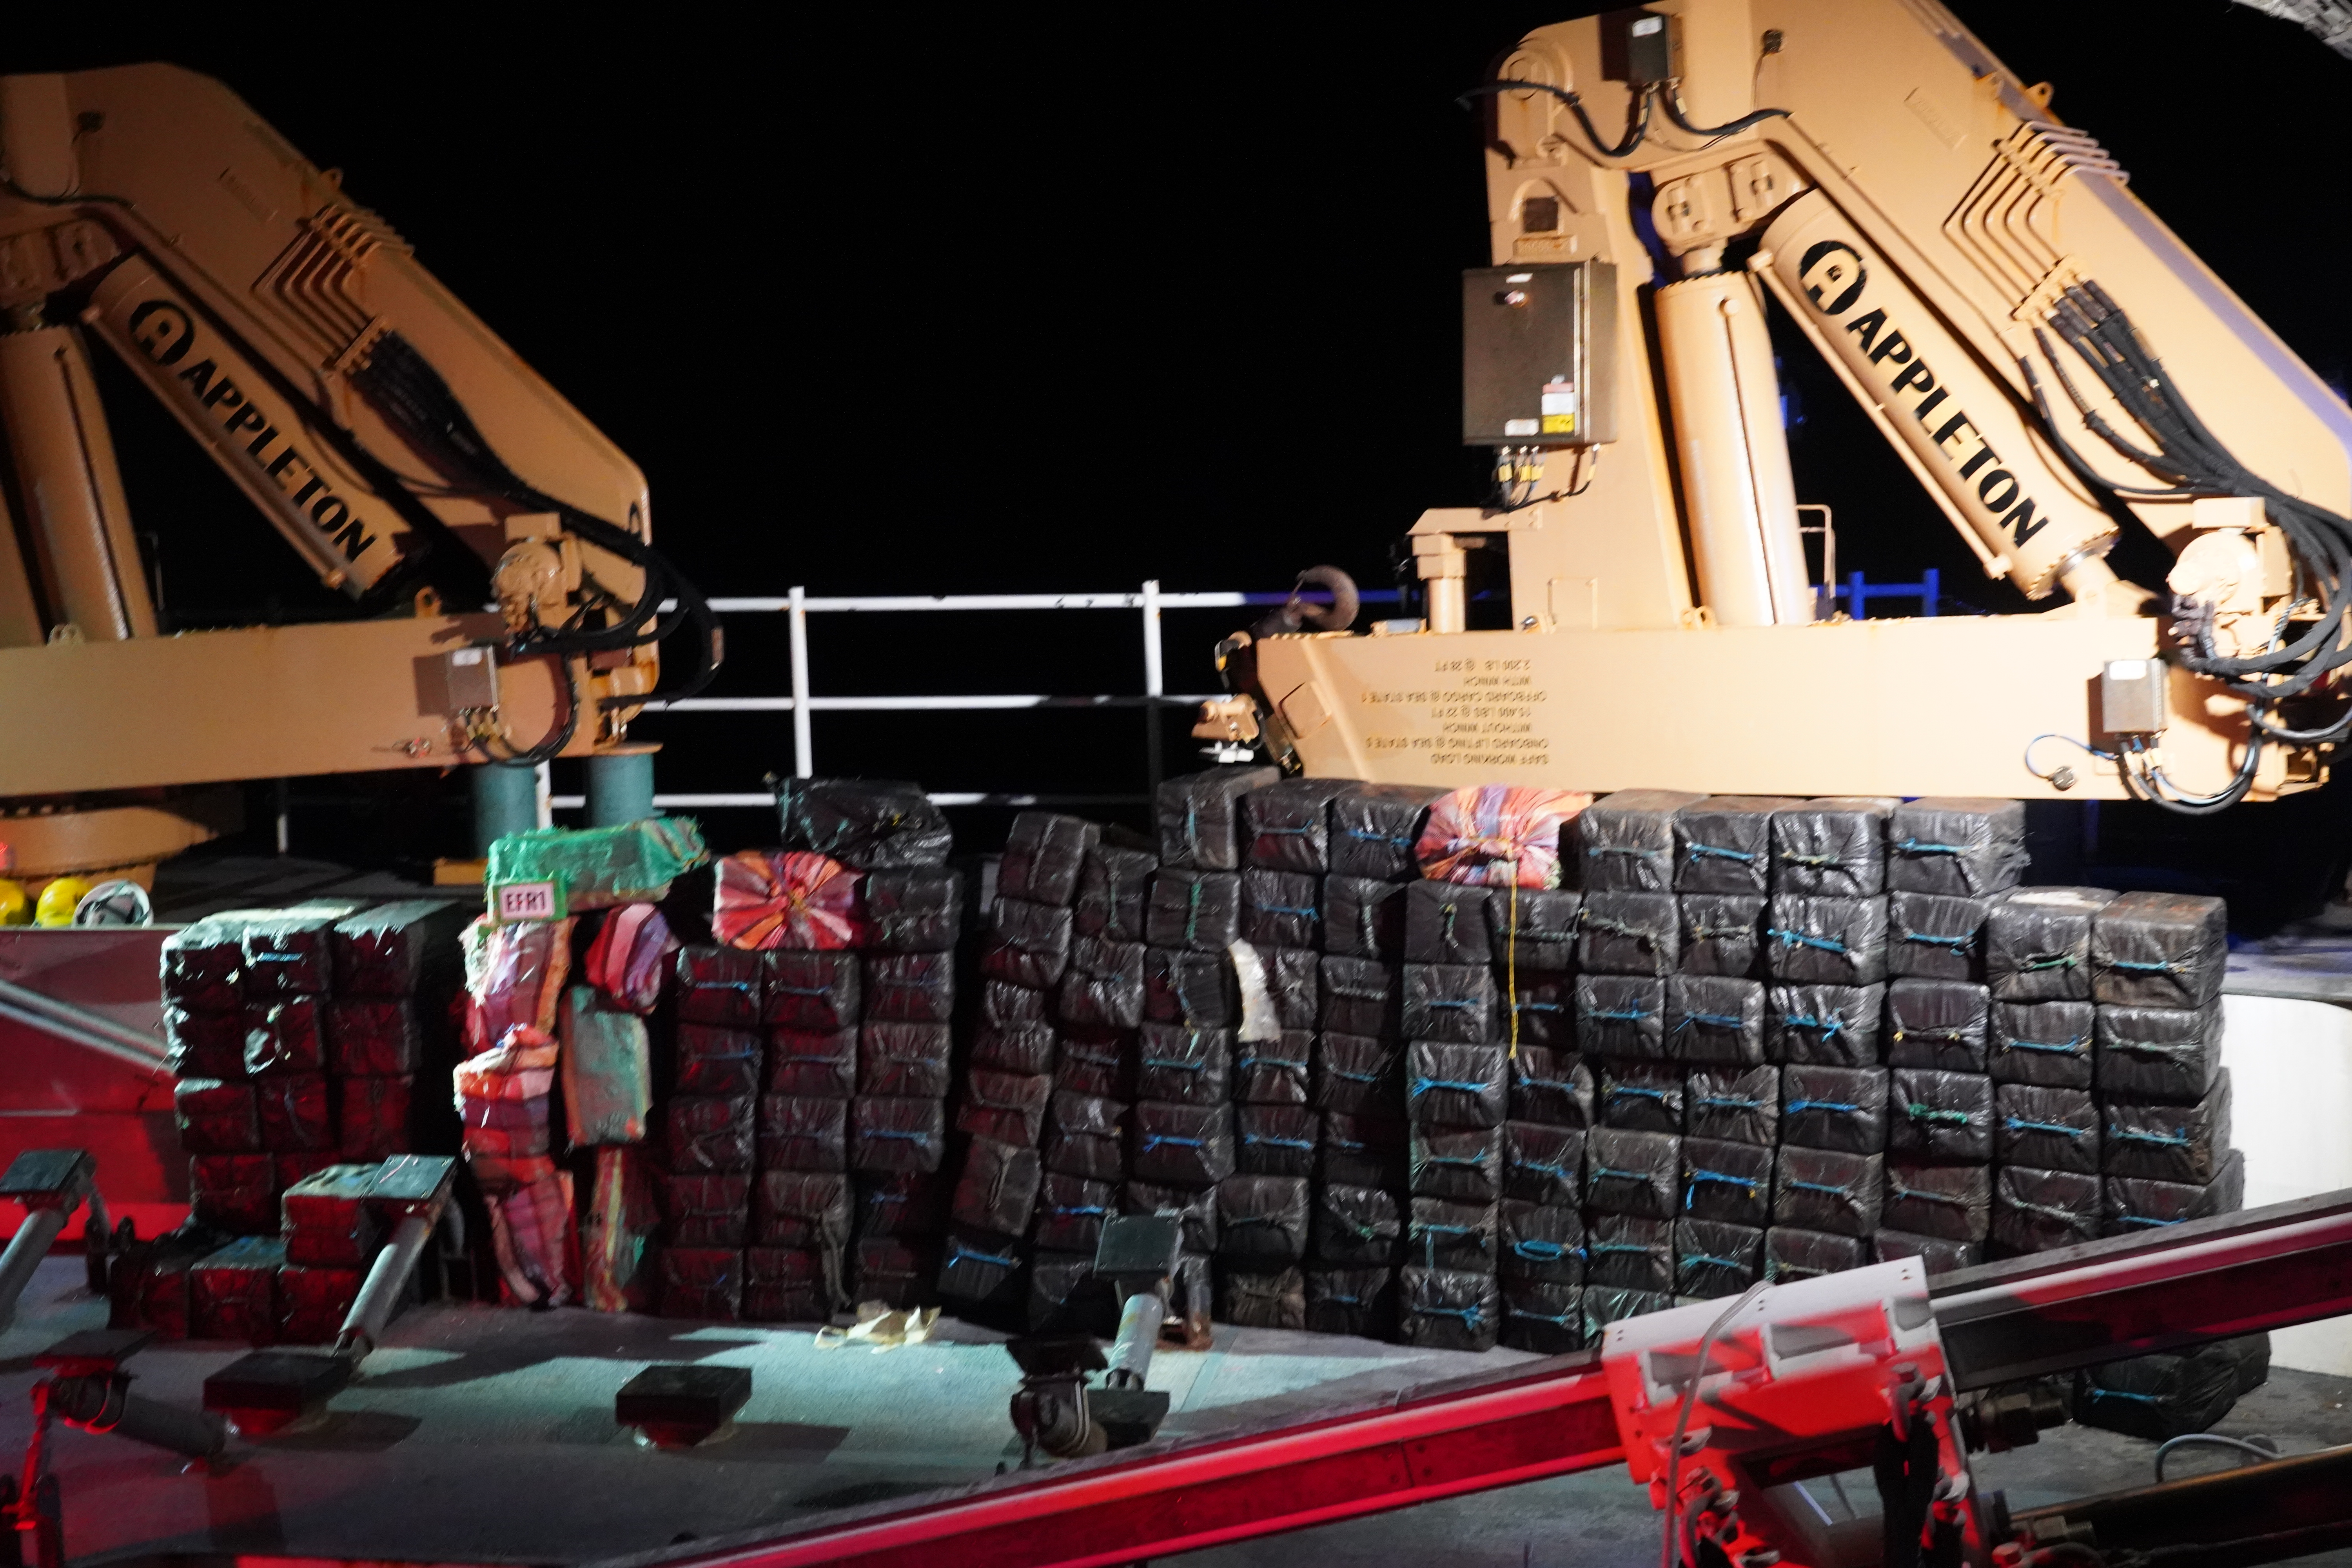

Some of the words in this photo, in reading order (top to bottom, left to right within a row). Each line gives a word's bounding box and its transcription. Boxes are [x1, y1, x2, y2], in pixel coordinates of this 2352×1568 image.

[1846, 307, 2050, 548] APPLETON
[178, 358, 377, 563] APPLETON
[1463, 675, 1500, 687] WINCH
[1503, 675, 1532, 686] WITH
[1370, 691, 1404, 703] STATE
[1406, 691, 1427, 703] SEA
[1443, 691, 1483, 702] CARGO
[1484, 691, 1547, 703] OFFBOARD
[1443, 722, 1479, 733] WINCH
[1482, 722, 1532, 733] WITHOUT
[1374, 738, 1408, 749] STATE
[1411, 737, 1432, 749] SEA
[1448, 738, 1490, 749] LIFTING
[1491, 738, 1549, 749] ONBOARD
[1430, 753, 1462, 764] LOAD
[1463, 753, 1516, 765] WORKING
